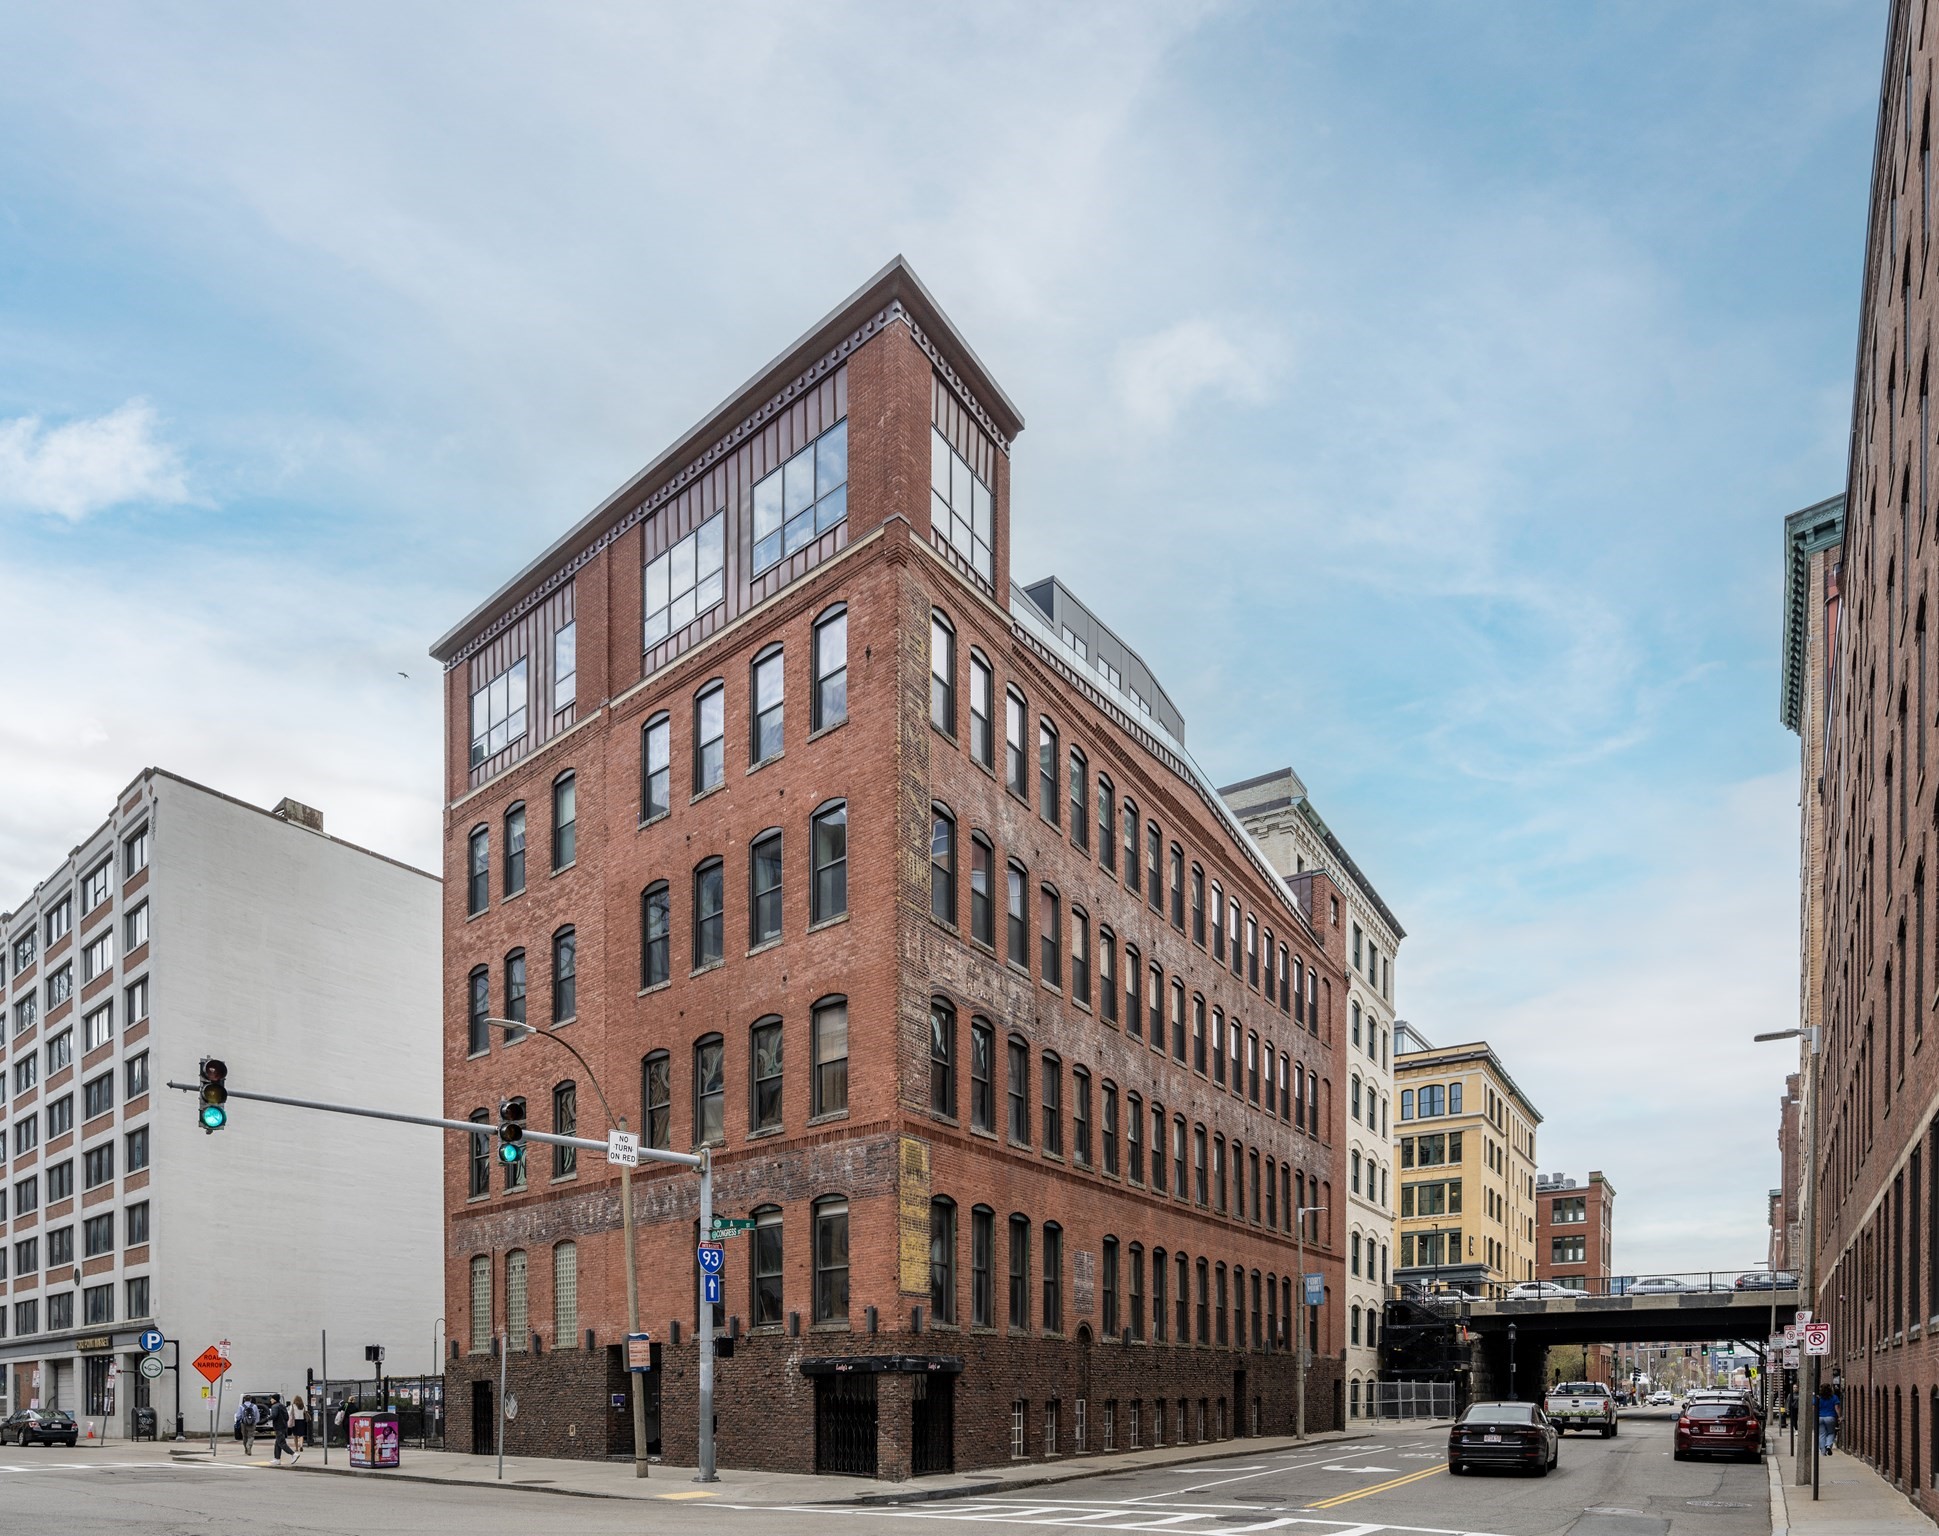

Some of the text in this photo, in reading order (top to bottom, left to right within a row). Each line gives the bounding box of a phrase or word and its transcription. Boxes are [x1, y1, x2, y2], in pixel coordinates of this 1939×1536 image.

[619, 1135, 629, 1143] NO
[615, 1143, 633, 1152] TURN
[610, 1152, 636, 1163] ON RED
[716, 1227, 737, 1238] CONGRESS
[702, 1250, 719, 1267] 93
[1307, 1277, 1321, 1285] FORT
[147, 1333, 161, 1349] P
